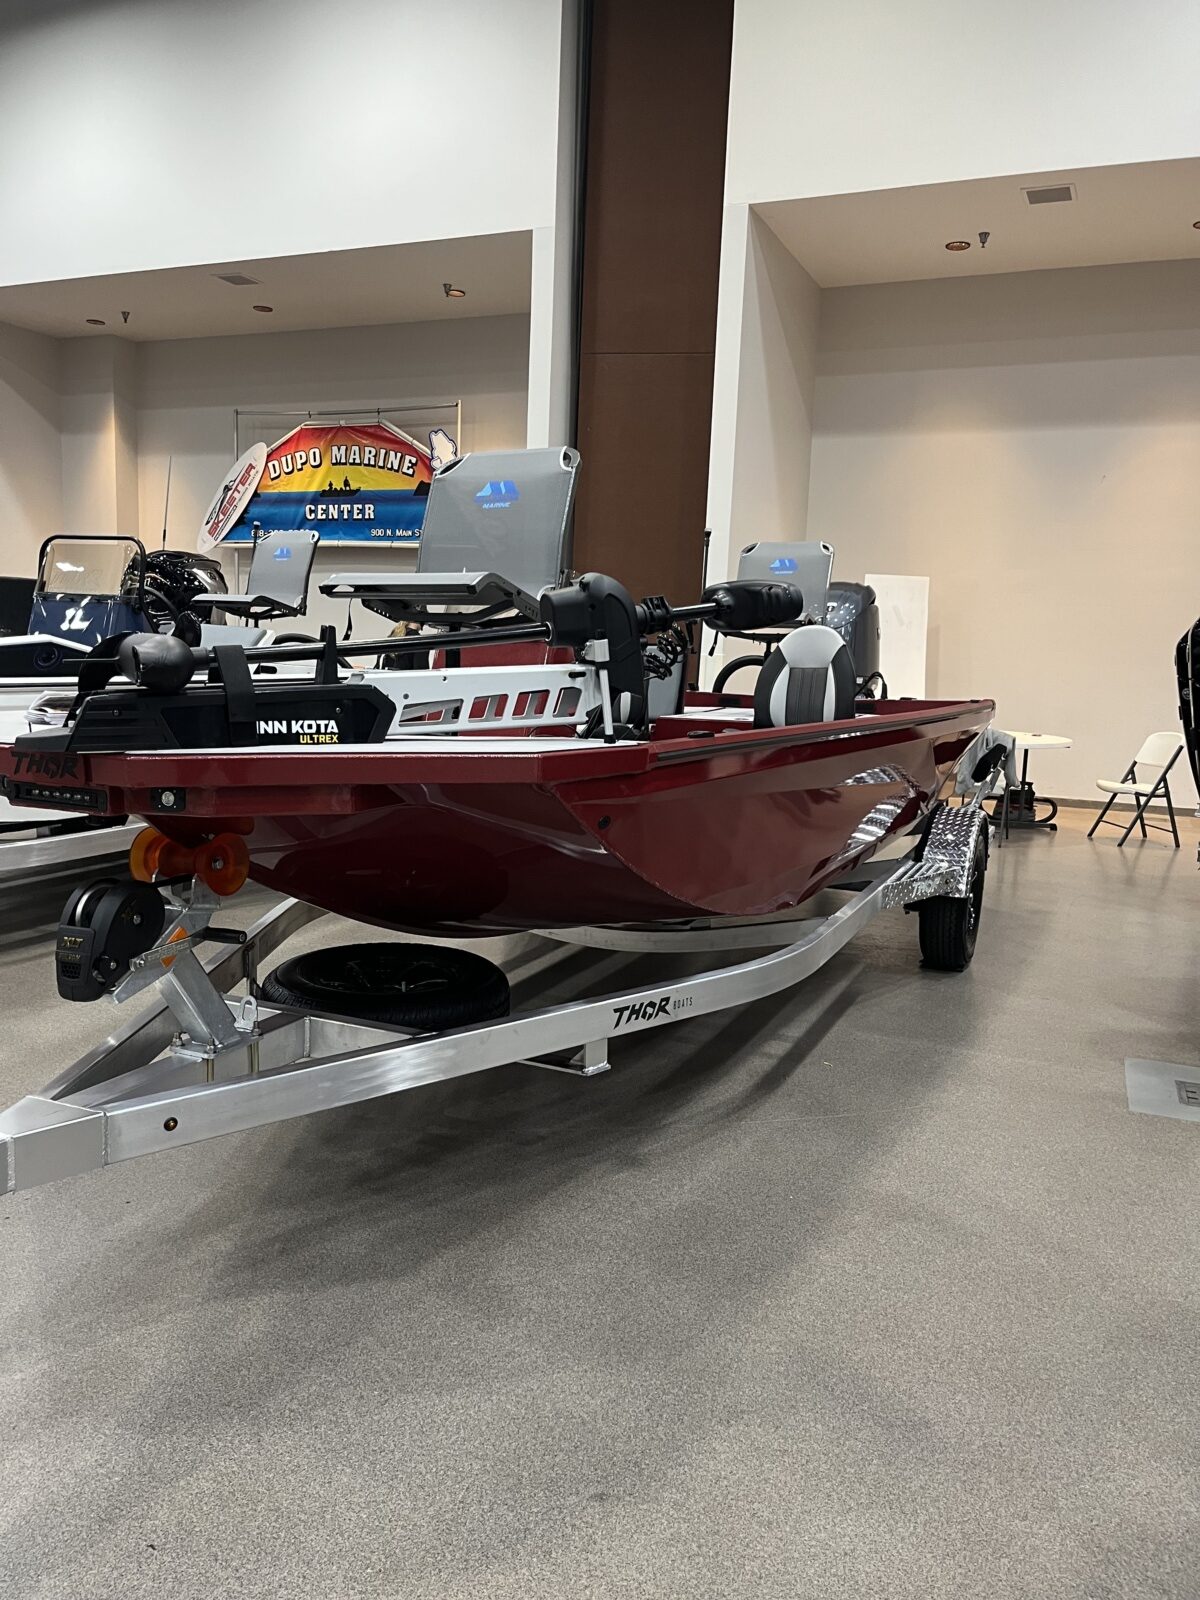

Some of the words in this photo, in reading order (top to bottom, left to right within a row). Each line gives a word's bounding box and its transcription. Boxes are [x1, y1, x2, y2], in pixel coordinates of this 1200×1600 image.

[267, 447, 322, 480] DUPO
[331, 445, 418, 477] MARINE
[207, 463, 257, 538] SKEETER
[305, 503, 375, 520] CENTER
[370, 528, 385, 537] 900
[256, 720, 287, 734] NN
[291, 719, 339, 734] KOTA
[300, 734, 339, 743] ULTREX
[10, 750, 79, 780] THOR
[613, 996, 671, 1030] THOR
[673, 997, 693, 1010] BOATS
